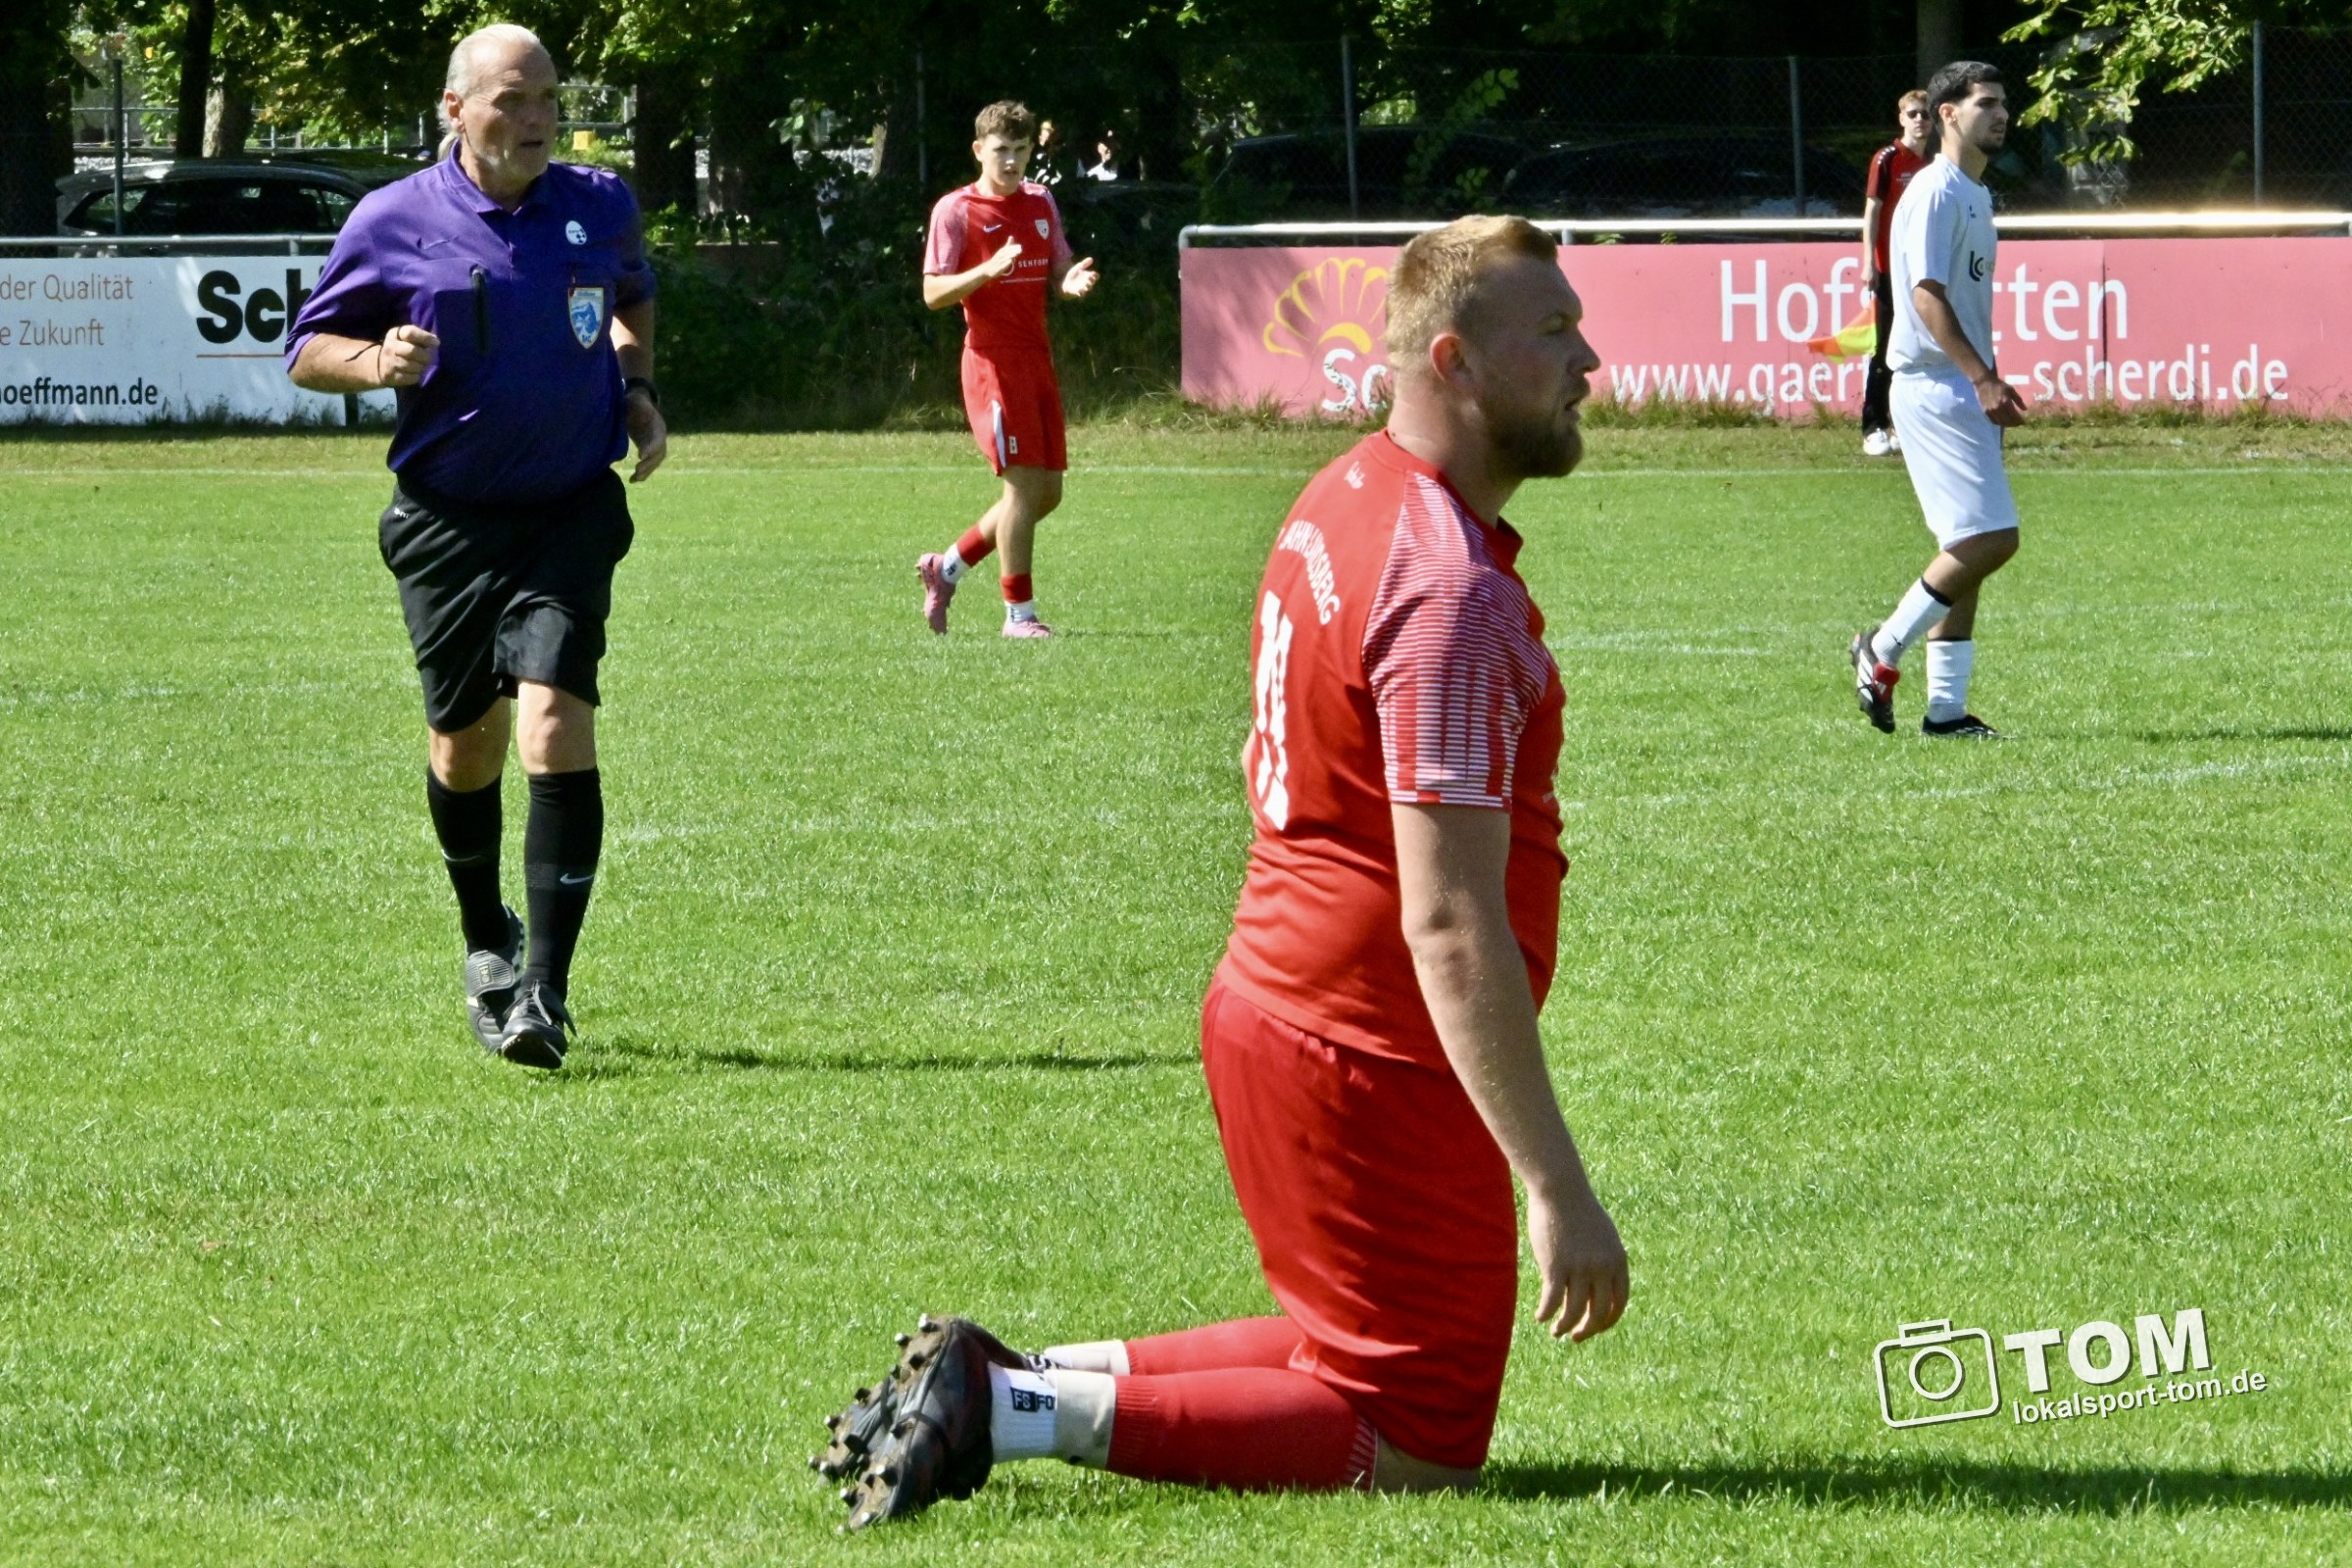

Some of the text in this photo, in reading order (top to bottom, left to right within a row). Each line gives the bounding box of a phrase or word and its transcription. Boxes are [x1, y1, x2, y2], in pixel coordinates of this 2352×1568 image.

[44, 273, 134, 302] Qualität
[19, 318, 105, 346] Zukunft
[0, 377, 159, 406] oeffmann.de
